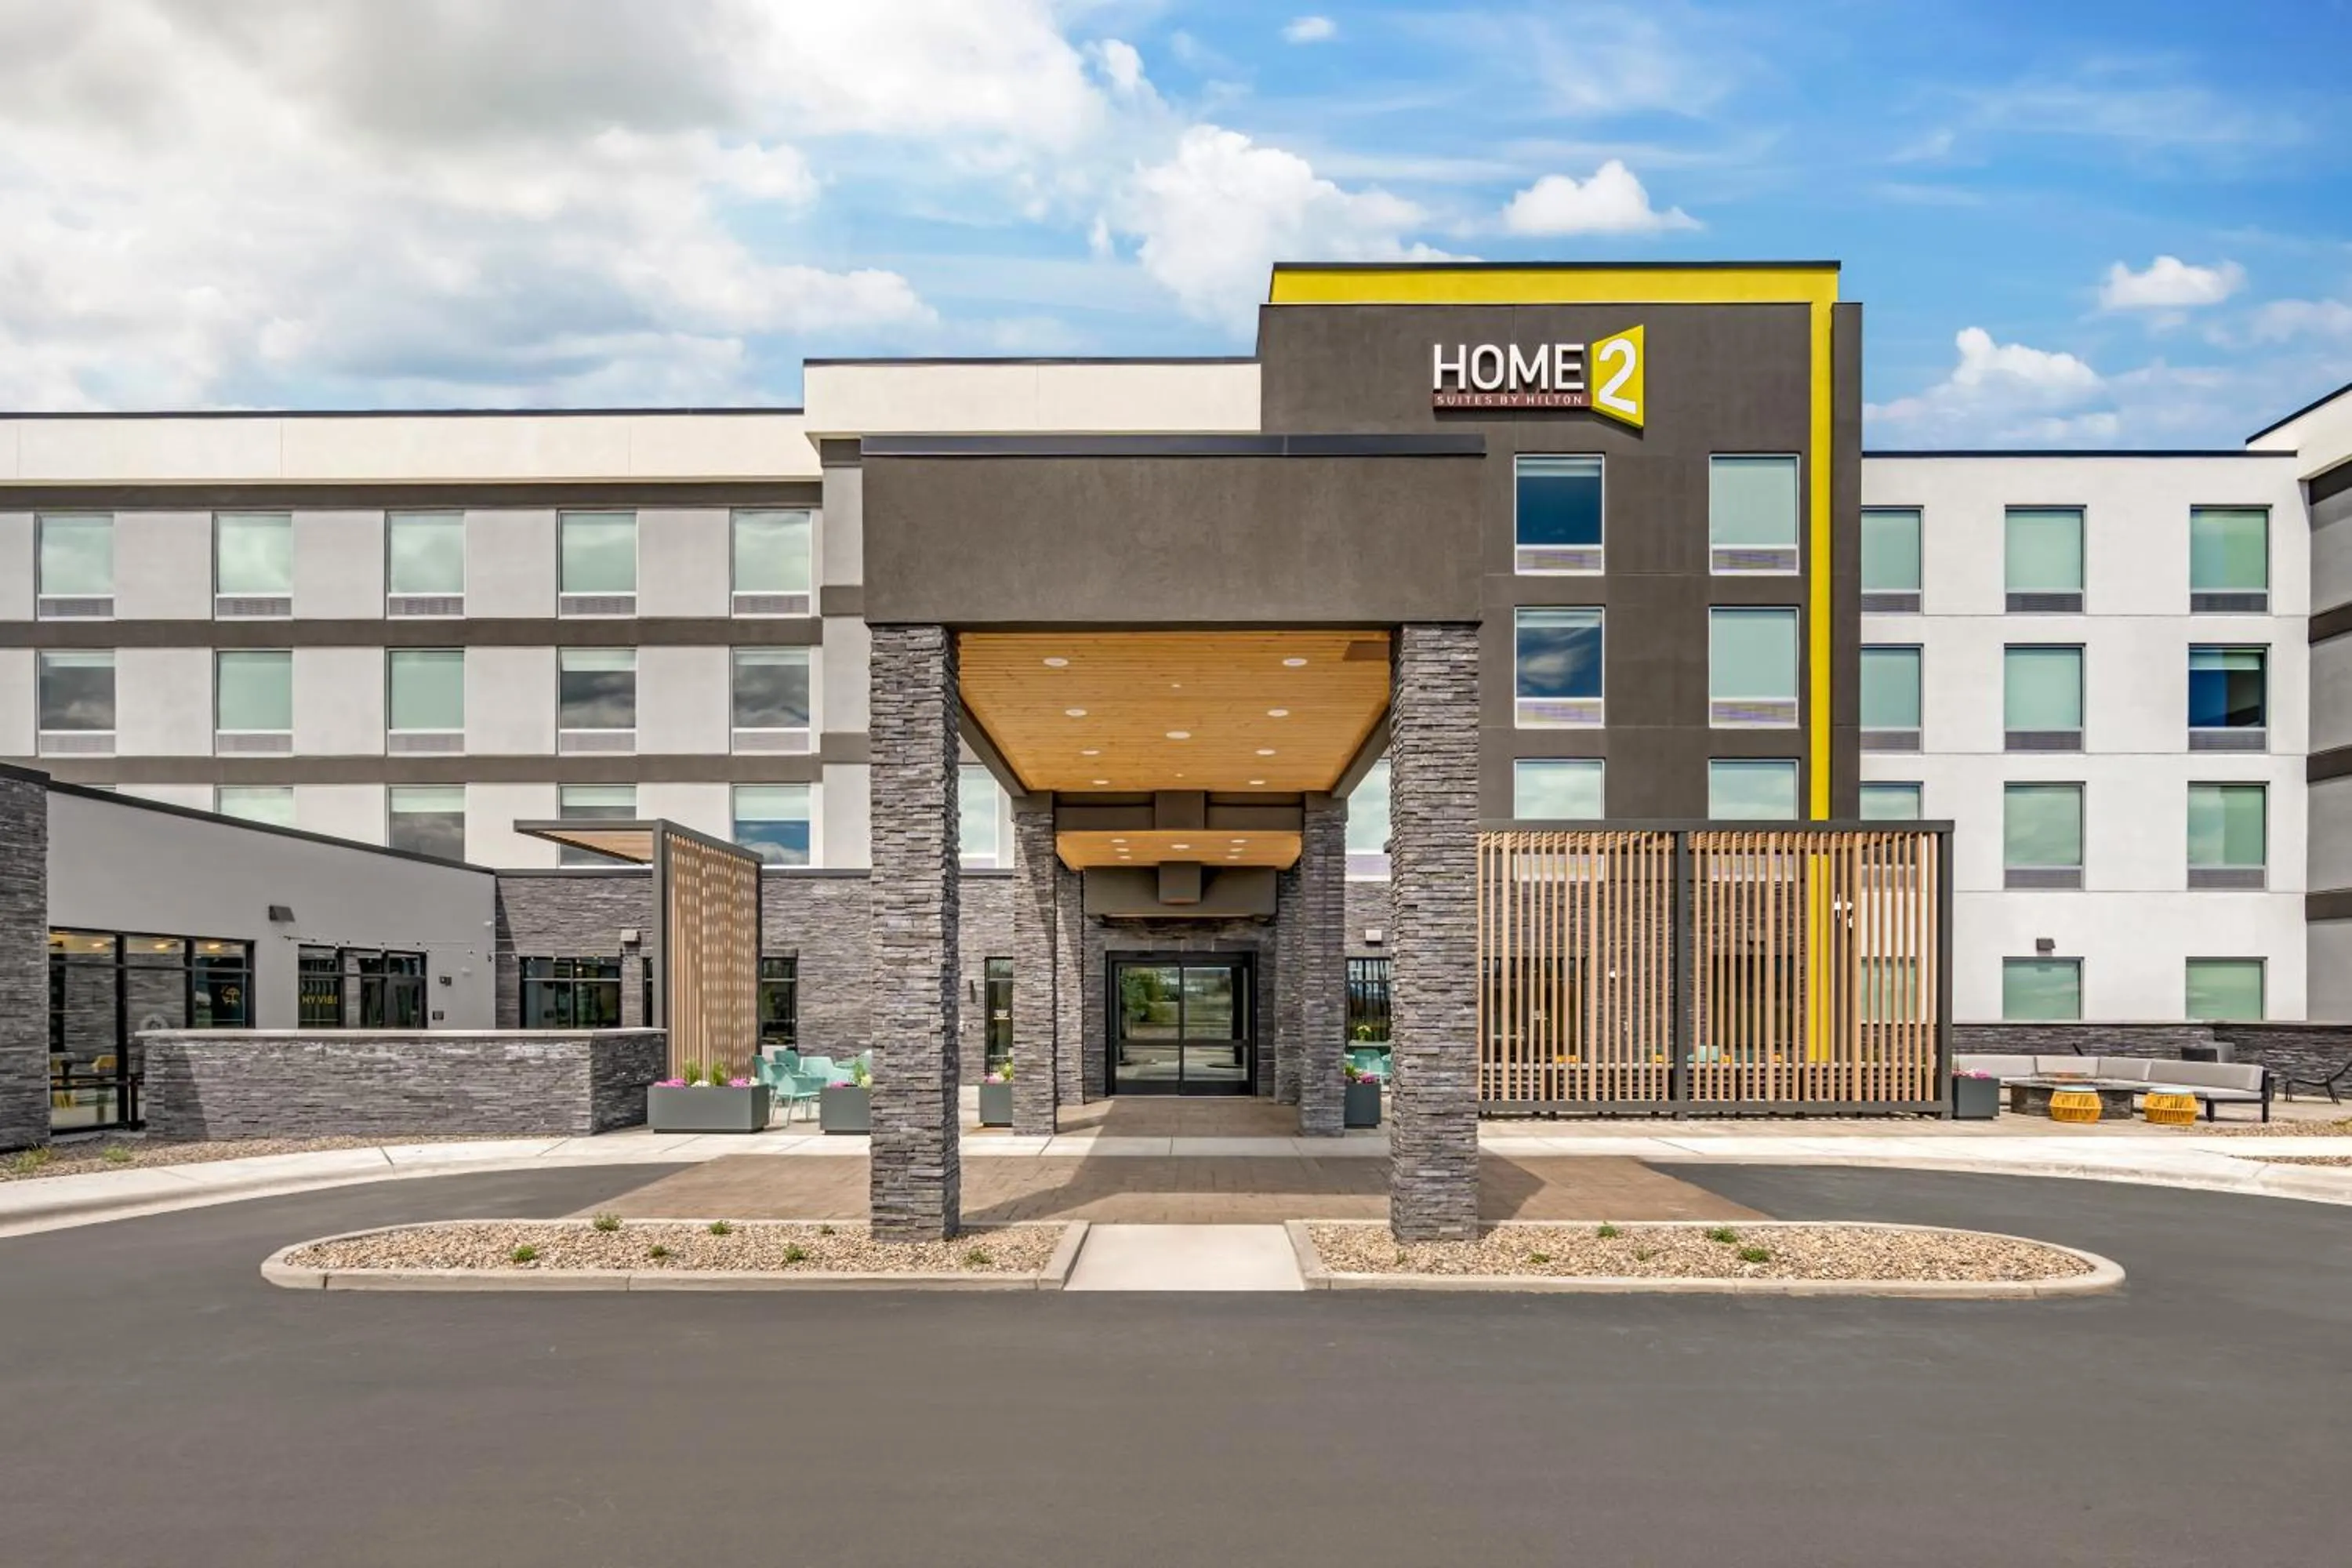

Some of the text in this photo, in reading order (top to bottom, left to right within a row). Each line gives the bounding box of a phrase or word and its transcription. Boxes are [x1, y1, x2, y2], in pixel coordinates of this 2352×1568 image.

[1433, 338, 1636, 415] HOME 2
[1436, 394, 1582, 405] SUITES BY HILTON
